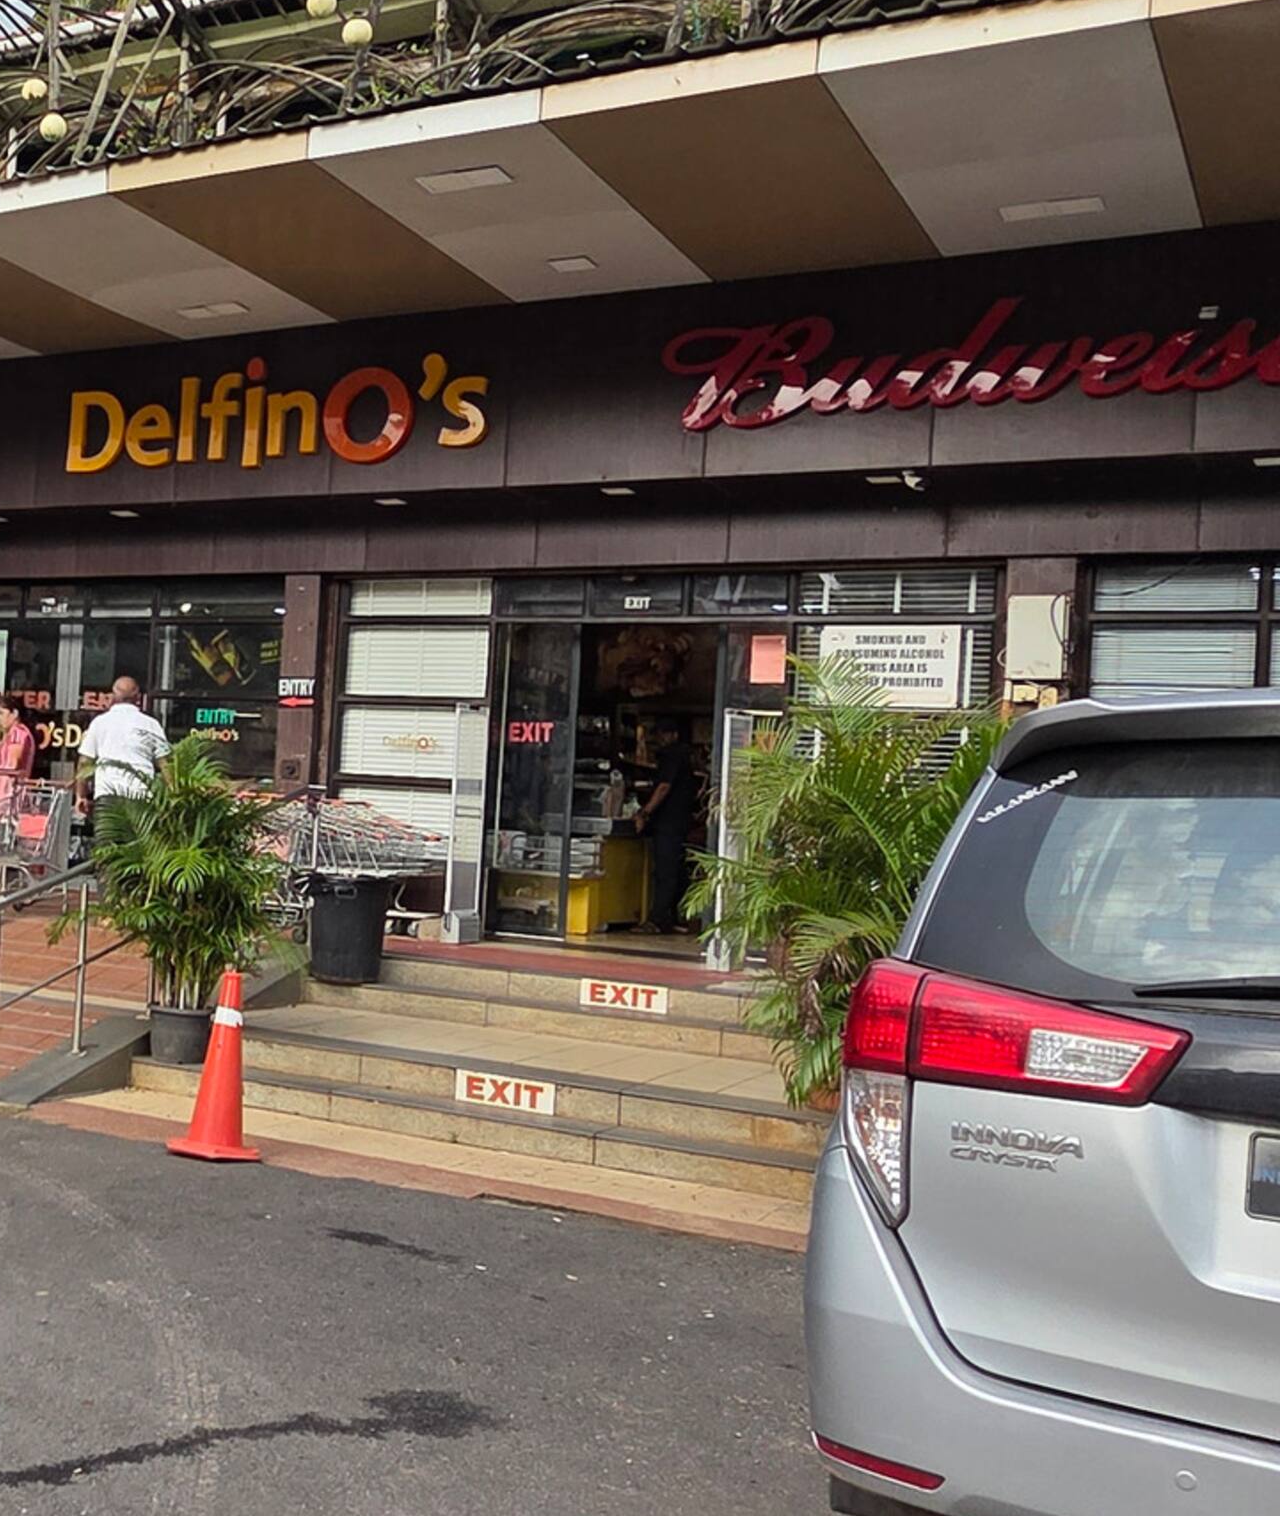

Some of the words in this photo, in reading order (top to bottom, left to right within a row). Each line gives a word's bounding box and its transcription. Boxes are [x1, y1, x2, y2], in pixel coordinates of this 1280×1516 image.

[66, 353, 489, 472] DelfinO's
[624, 596, 651, 609] EXIT
[855, 635, 902, 645] SMOKING
[905, 635, 926, 645] AND
[899, 649, 945, 660] ALCOHOL
[889, 663, 914, 673] AREA
[917, 663, 928, 673] IS
[278, 679, 315, 696] ENTRY
[882, 677, 944, 688] PROHIBITED
[196, 708, 237, 724] ENTRY
[508, 722, 555, 743] EXIT
[589, 983, 658, 1009] EXIT
[466, 1075, 544, 1109] EXIT
[950, 1121, 1085, 1159] INNOVA
[950, 1145, 1058, 1173] CRYSTA
